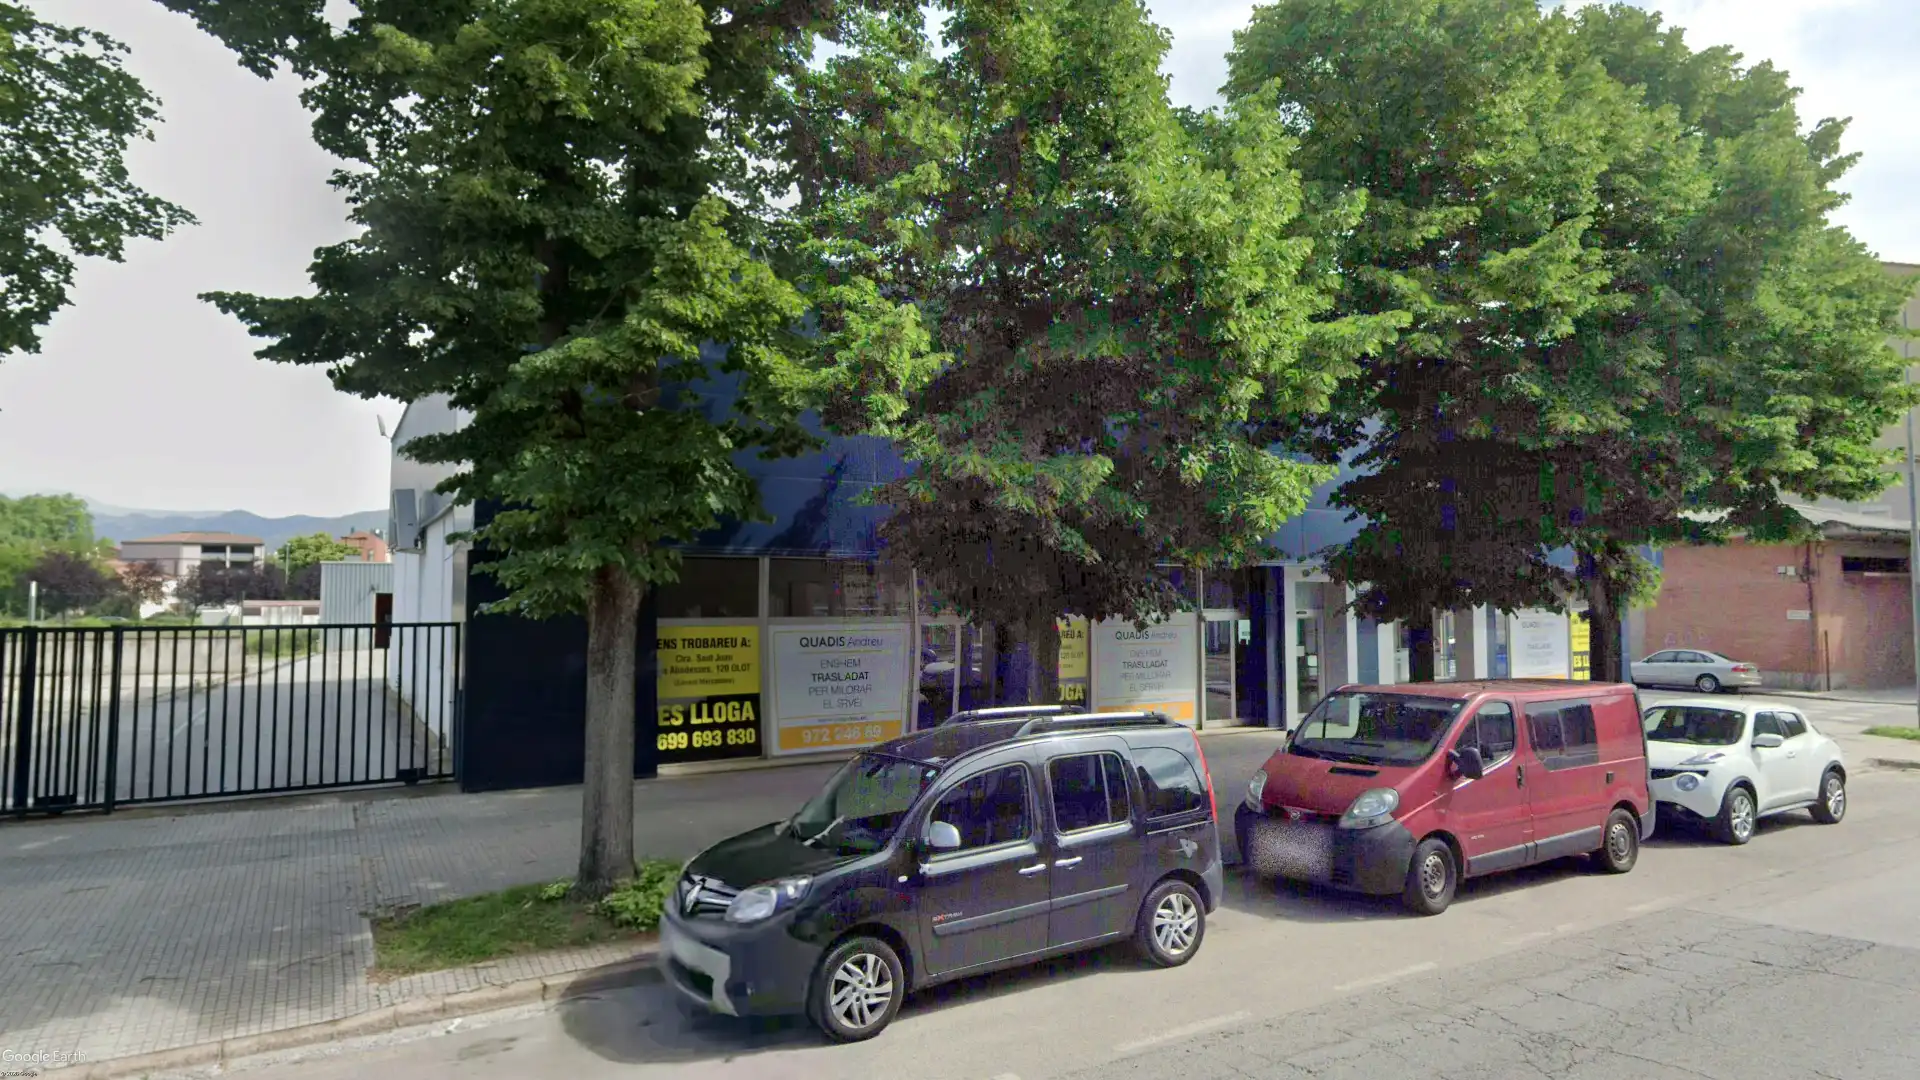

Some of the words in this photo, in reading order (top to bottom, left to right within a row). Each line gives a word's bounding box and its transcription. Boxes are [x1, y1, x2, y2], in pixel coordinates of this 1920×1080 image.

[1115, 630, 1150, 641] QUADIS
[656, 638, 677, 650] ENS
[681, 637, 738, 649] TROBAREU
[740, 637, 751, 648] A:
[799, 636, 845, 648] QUADIS
[846, 636, 884, 648] Andreu
[808, 686, 828, 697] PER
[822, 700, 834, 710] EL
[658, 704, 684, 726] ES
[690, 701, 755, 725] LLOGA
[657, 732, 688, 751] 699
[692, 730, 722, 748] 693
[727, 728, 756, 745] 830
[802, 727, 831, 744] 972
